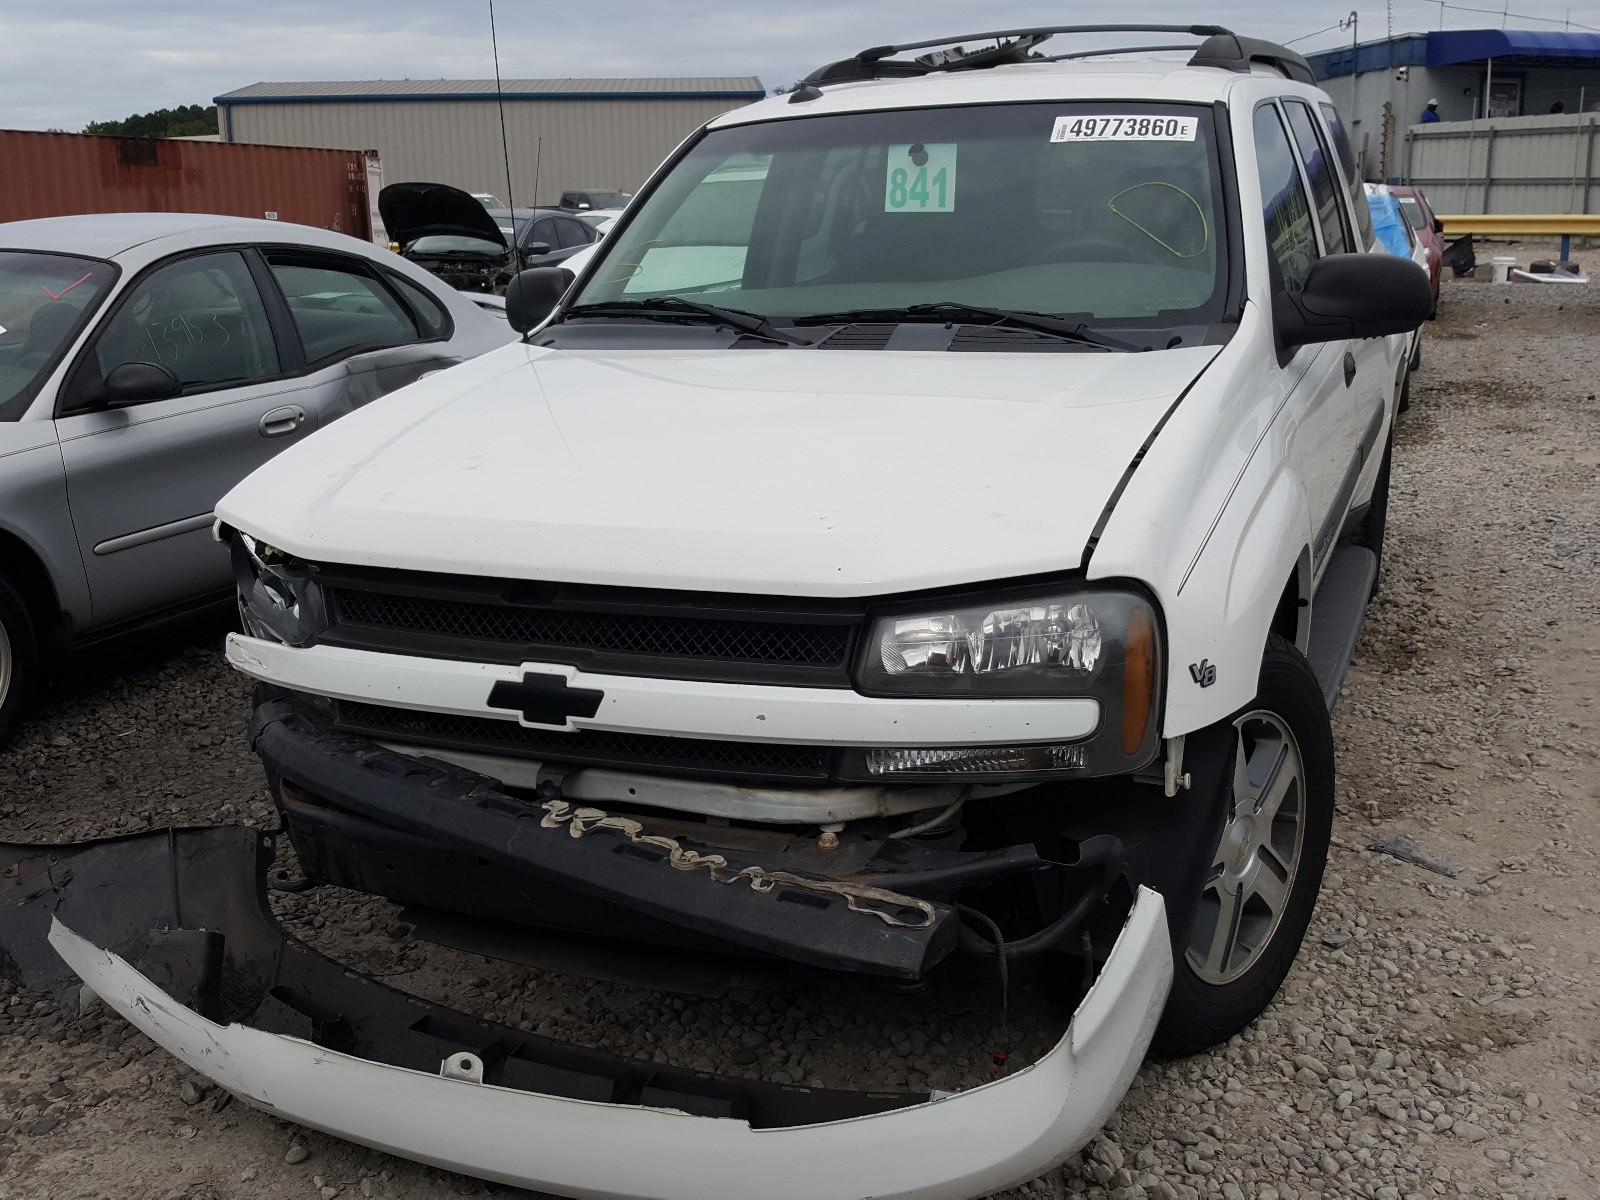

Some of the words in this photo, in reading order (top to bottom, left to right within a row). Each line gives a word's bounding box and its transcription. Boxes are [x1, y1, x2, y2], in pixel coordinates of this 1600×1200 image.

[1069, 118, 1179, 137] 49773860
[1180, 125, 1189, 135] E
[889, 166, 947, 209] 841
[1188, 658, 1217, 688] V8
